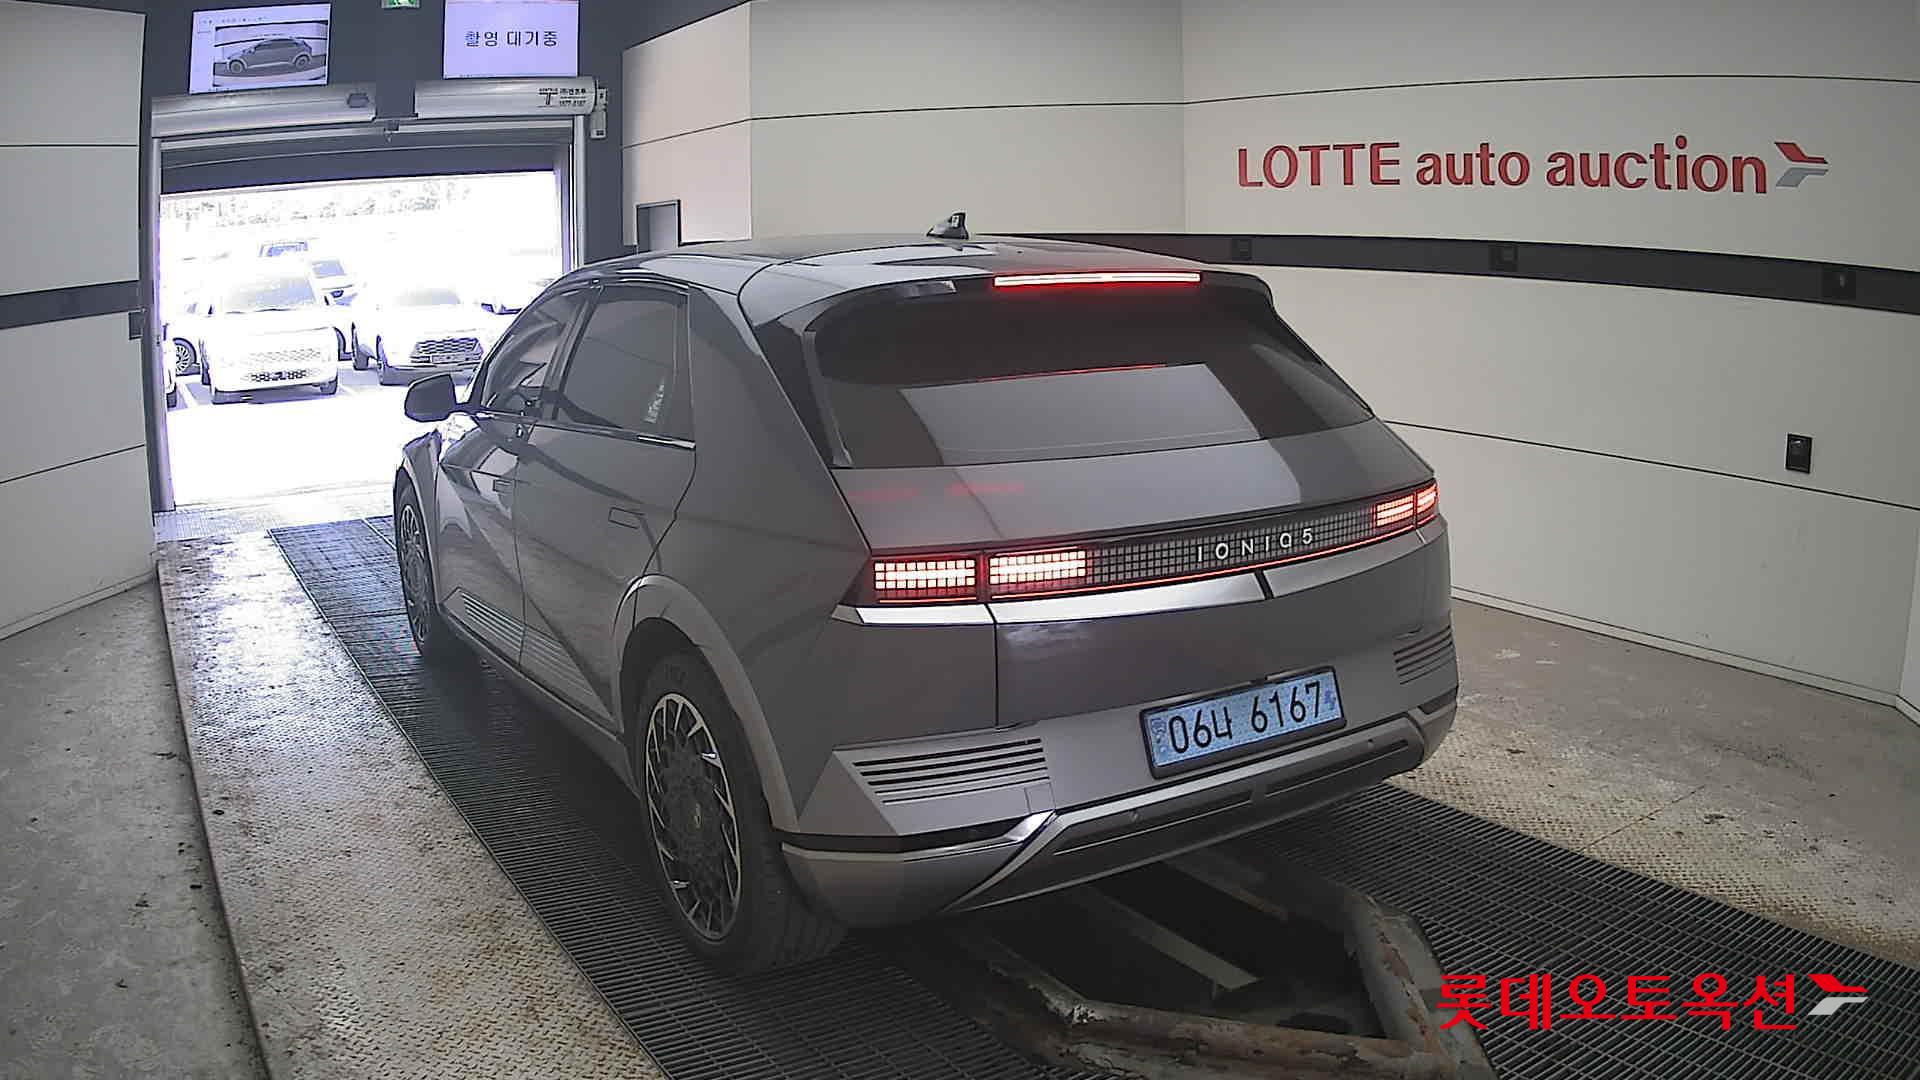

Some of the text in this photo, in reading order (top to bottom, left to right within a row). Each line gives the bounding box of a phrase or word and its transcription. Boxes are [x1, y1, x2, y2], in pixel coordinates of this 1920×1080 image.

[507, 31, 558, 47] 대기중
[1237, 135, 1768, 194] LOTTE auto auction
[1197, 528, 1313, 562] IONIQ 5
[1251, 681, 1321, 733] 6167
